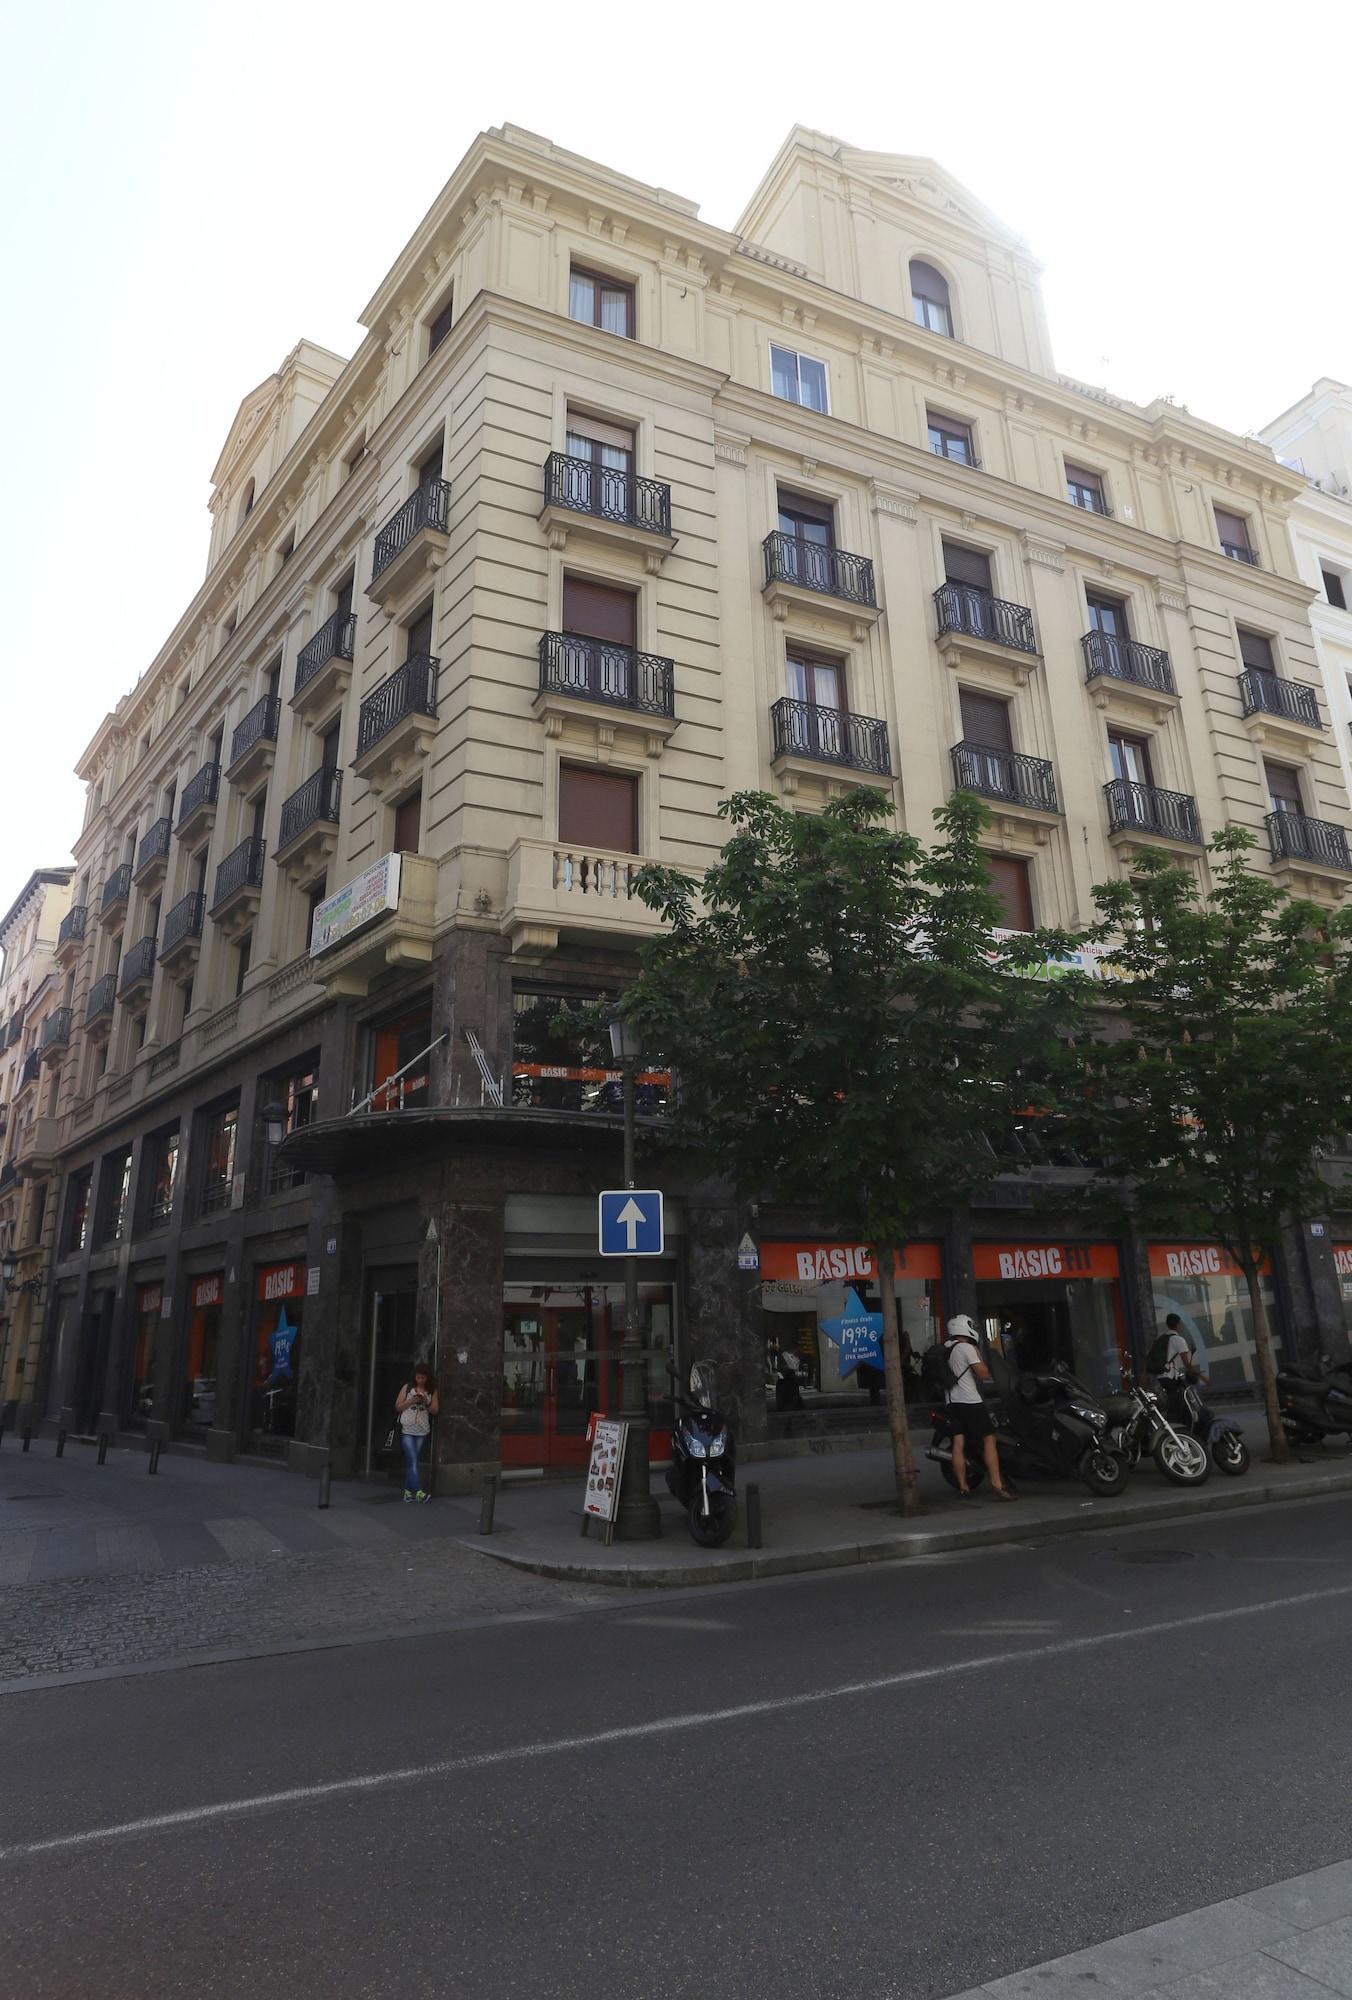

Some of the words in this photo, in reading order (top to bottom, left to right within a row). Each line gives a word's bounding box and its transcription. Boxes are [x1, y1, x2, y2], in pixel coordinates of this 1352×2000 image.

[540, 1067, 567, 1078] BASIC
[605, 1072, 623, 1082] BAS
[796, 1246, 872, 1280] BASIC
[998, 1247, 1062, 1279] BASIC
[1166, 1248, 1221, 1277] BASIC
[196, 1277, 220, 1307] BASIC
[264, 1266, 295, 1300] BASIC
[842, 1326, 868, 1346] 19,99
[869, 1330, 878, 1342] €
